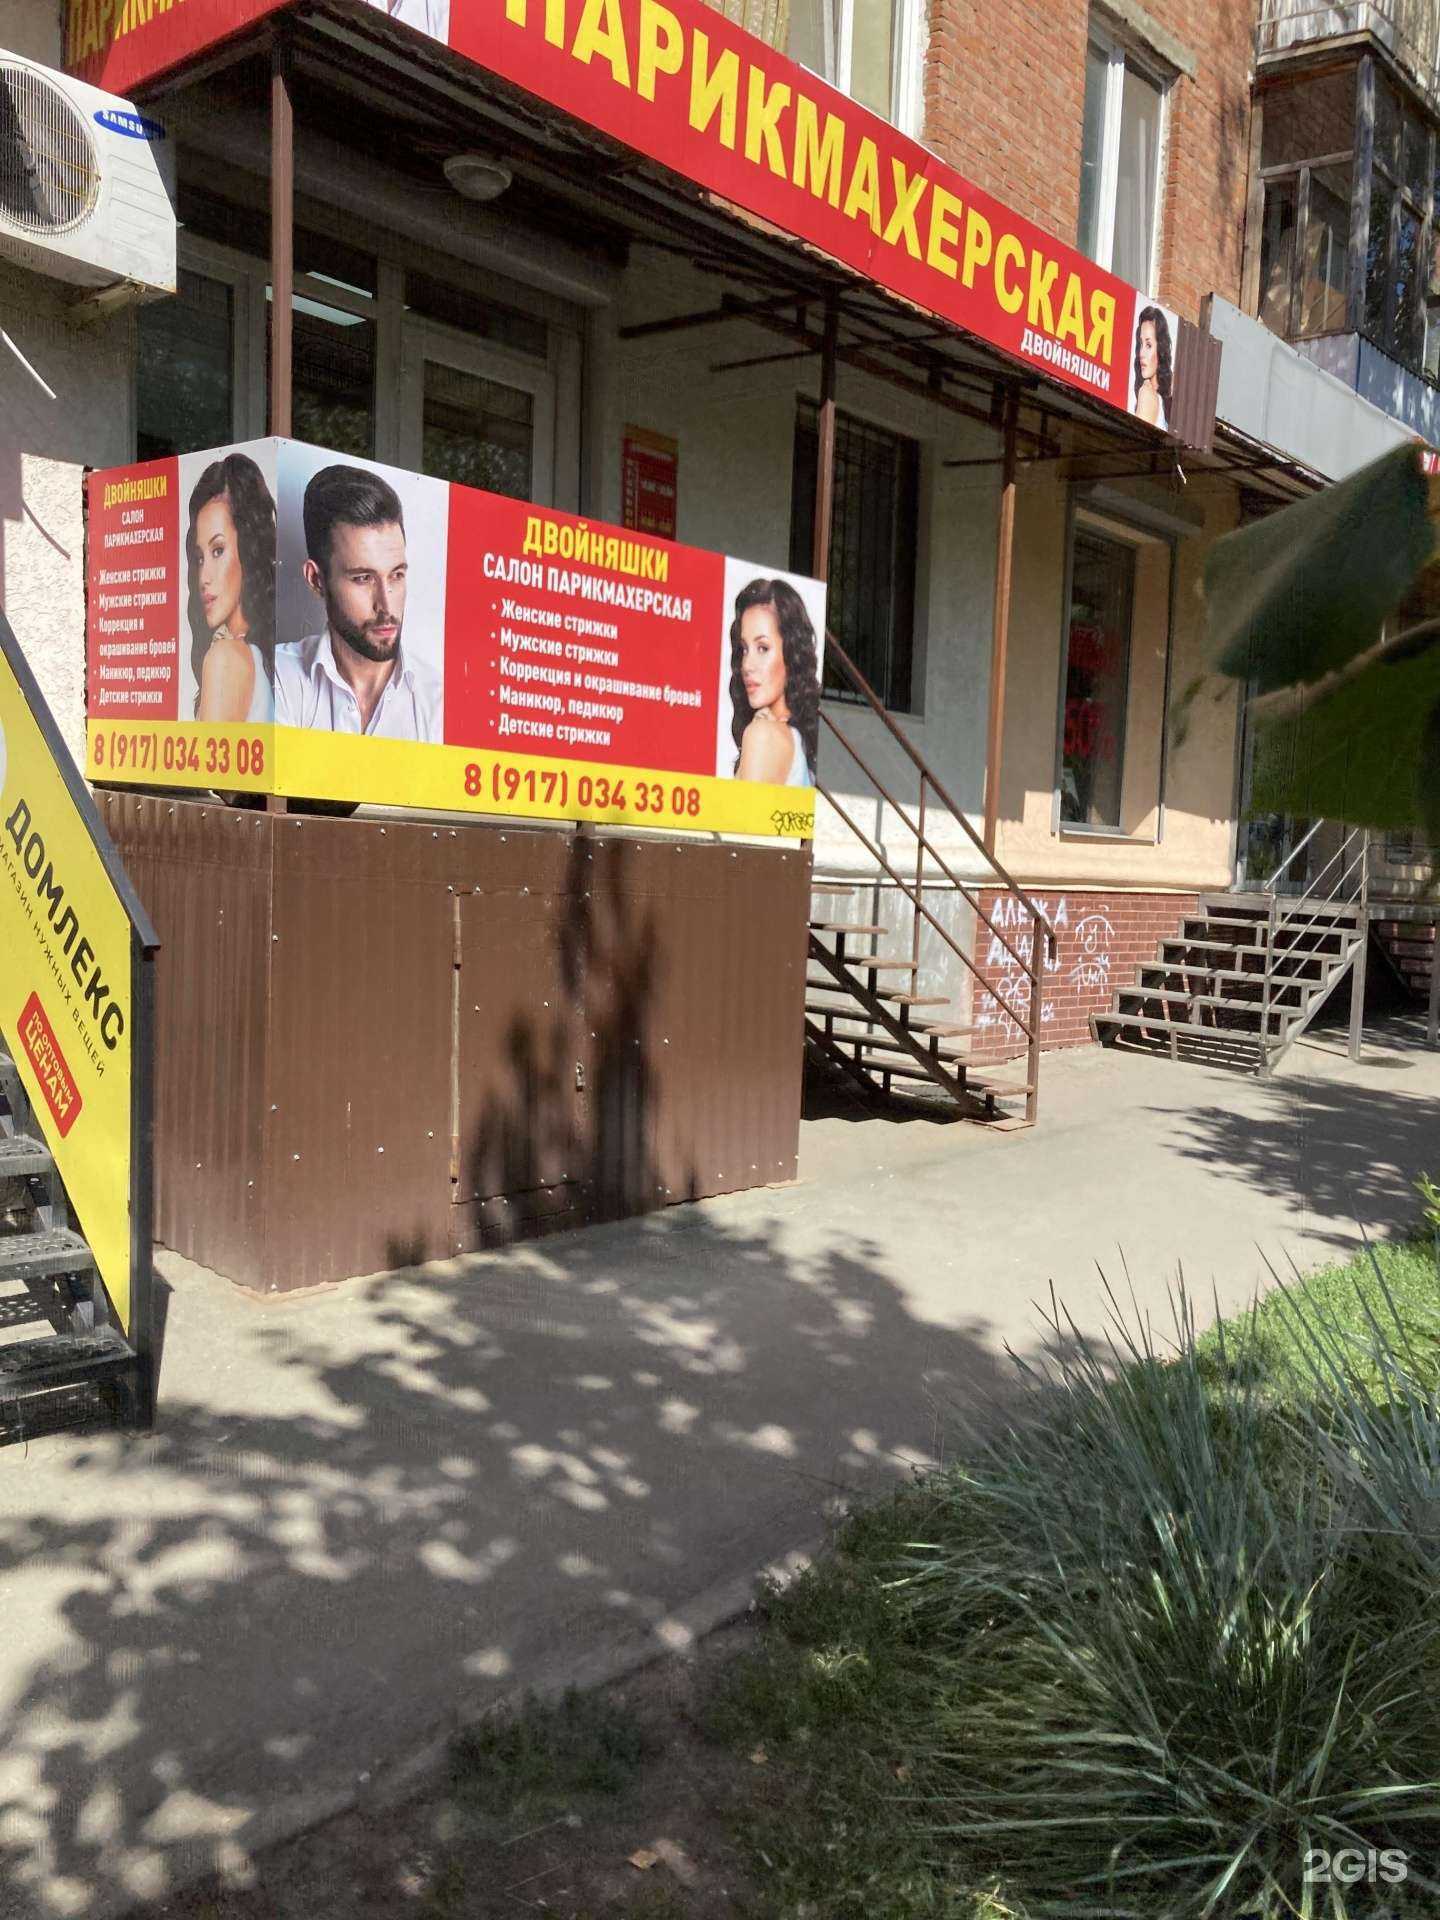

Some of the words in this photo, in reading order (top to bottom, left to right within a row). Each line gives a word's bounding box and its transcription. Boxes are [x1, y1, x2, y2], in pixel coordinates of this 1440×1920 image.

[1020, 327, 1111, 392] ДВОЙНЯШКИ
[103, 475, 167, 510] ДВОЙНЯШКИ
[121, 509, 144, 525] САЛОН
[104, 527, 164, 549] ПАРИКМАХЕРСКАЯ
[523, 517, 669, 583] ДВОЙНЯШКИ
[99, 569, 131, 585] Женские
[132, 566, 166, 585] стрижки
[483, 552, 543, 589] САЛОН
[547, 567, 693, 622] ПАРИКМАХЕРСКАЯ
[99, 592, 132, 612] Мужские
[133, 591, 167, 610] стрижки
[501, 598, 561, 628] Женские
[564, 615, 618, 640] стрижки
[99, 617, 138, 634] Коррекция
[99, 642, 148, 659] окрашивание
[149, 638, 176, 657] бровей
[500, 626, 562, 656] Мужские
[565, 643, 619, 667] стрижки
[136, 666, 171, 682] педикюр
[500, 656, 571, 689] Коррекция
[573, 675, 582, 689] и
[584, 674, 662, 702] окрашивание
[664, 684, 702, 708] бровей
[99, 687, 129, 706] Детские
[130, 690, 163, 707] стрижки
[500, 684, 566, 716] Маникюр,
[568, 698, 624, 725] педикюр
[498, 713, 553, 738] Детские
[556, 725, 611, 746] стрижки
[95, 733, 105, 766] 8
[110, 731, 157, 771] (917)
[164, 736, 200, 771] 034
[206, 737, 230, 774] 33
[236, 738, 264, 776] 08
[464, 763, 482, 797] 8
[492, 762, 568, 808] (917)
[578, 775, 626, 811] 034
[635, 782, 664, 813] 33
[671, 786, 701, 817] 08
[5, 798, 124, 1051] ДОМЛЕКС
[33, 921, 71, 1004] НУЖНЫХ
[72, 1008, 105, 1078] ВЕЩЕЙ
[25, 1019, 69, 1118] ЦЕНАМ
